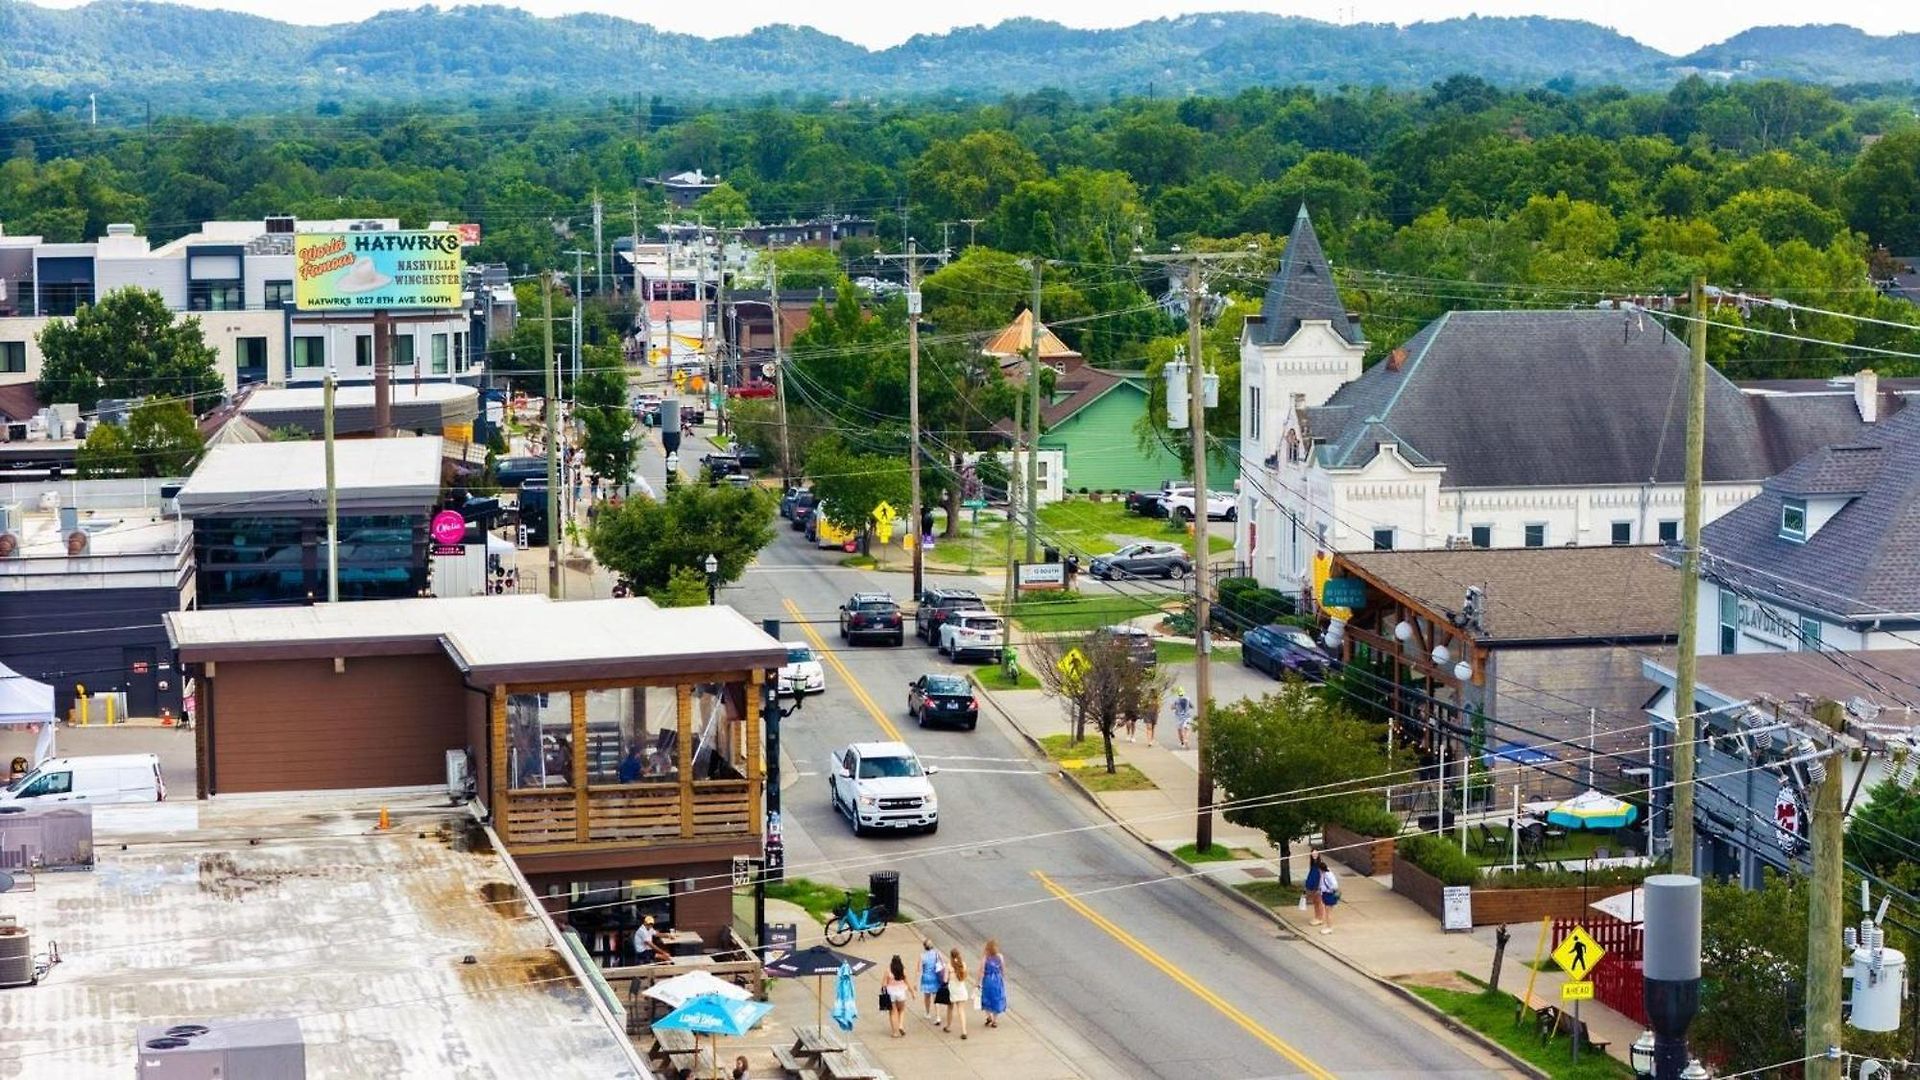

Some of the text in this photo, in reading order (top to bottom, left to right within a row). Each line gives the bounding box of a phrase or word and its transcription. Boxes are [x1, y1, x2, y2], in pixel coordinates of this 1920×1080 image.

[299, 235, 346, 261] World
[355, 236, 459, 254] HATWRKS
[299, 252, 355, 280] Famous
[397, 260, 456, 271] NASHVILLE
[395, 275, 460, 285] WINCHESTER
[308, 297, 352, 306] HATWRKS
[398, 296, 416, 304] AVE
